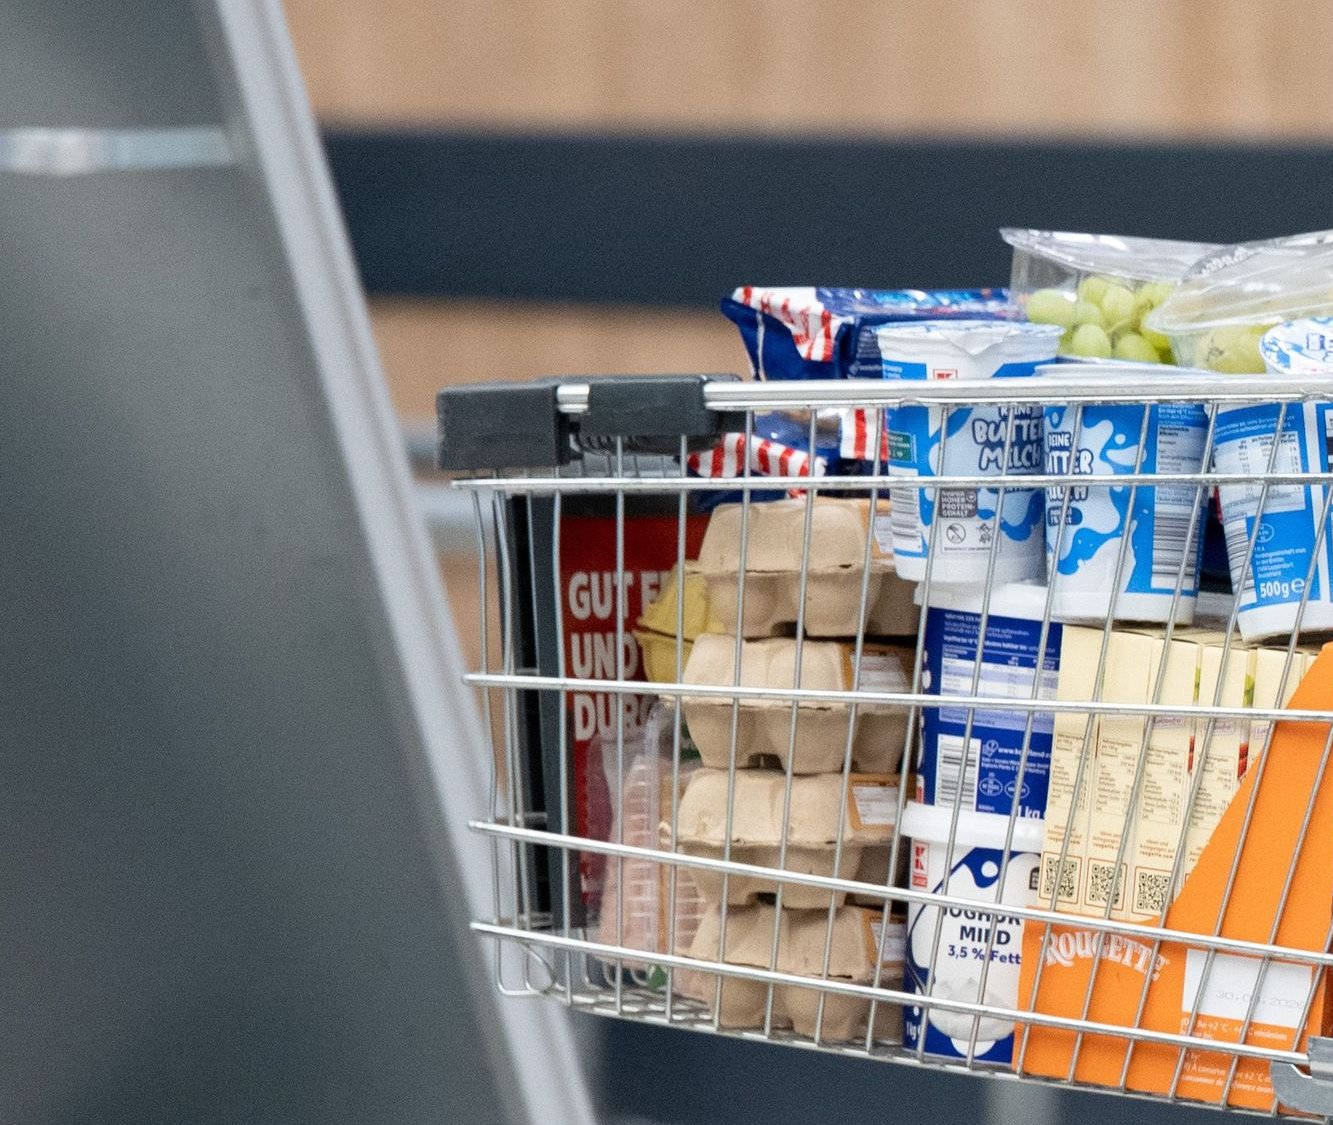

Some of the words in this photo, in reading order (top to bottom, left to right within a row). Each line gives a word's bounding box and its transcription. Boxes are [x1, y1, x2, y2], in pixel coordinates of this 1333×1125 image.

[568, 570, 634, 621] GUT
[1260, 580, 1290, 598] 500g
[570, 631, 639, 680] UND
[948, 945, 968, 960] 3,5
[990, 950, 1022, 966] Fett
